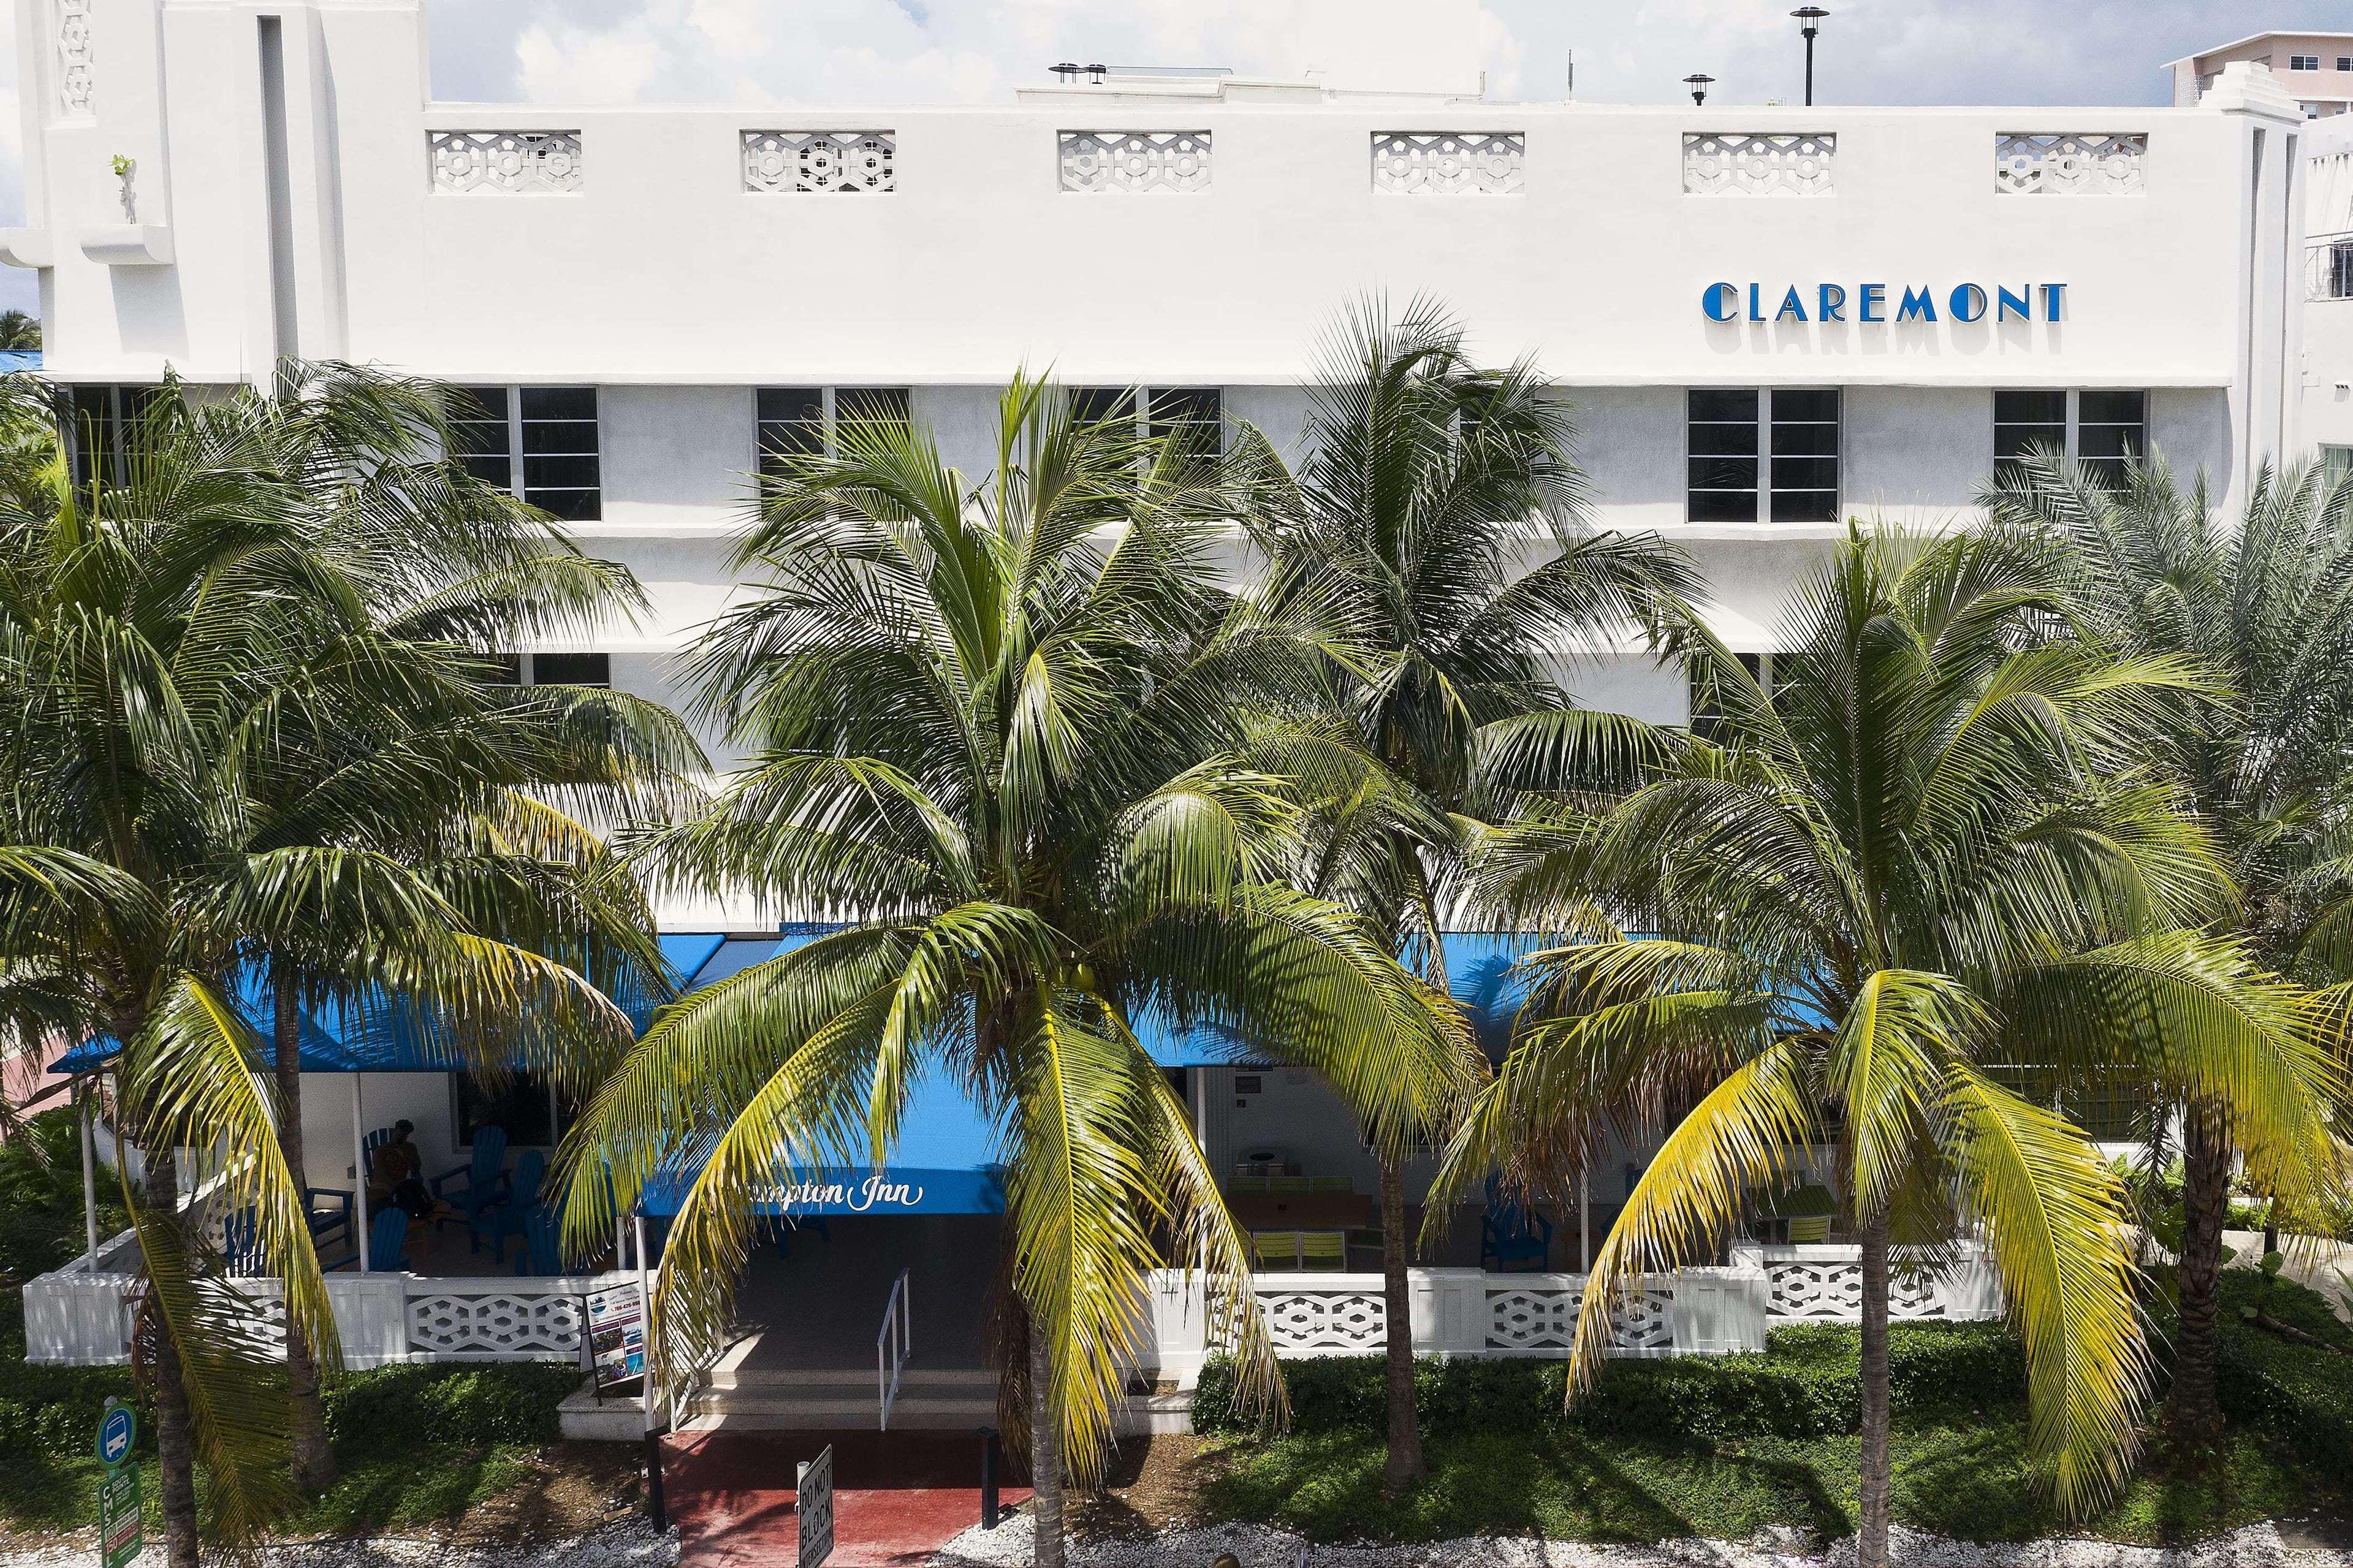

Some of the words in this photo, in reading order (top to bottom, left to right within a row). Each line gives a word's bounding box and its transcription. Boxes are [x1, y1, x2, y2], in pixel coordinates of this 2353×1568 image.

[1702, 282, 2067, 323] CLAREMONT
[847, 1174, 923, 1211] Inn
[112, 1473, 128, 1487] SOUTH
[802, 1485, 813, 1517] DO
[815, 1466, 830, 1501] NOT
[801, 1497, 831, 1551] BLOCK
